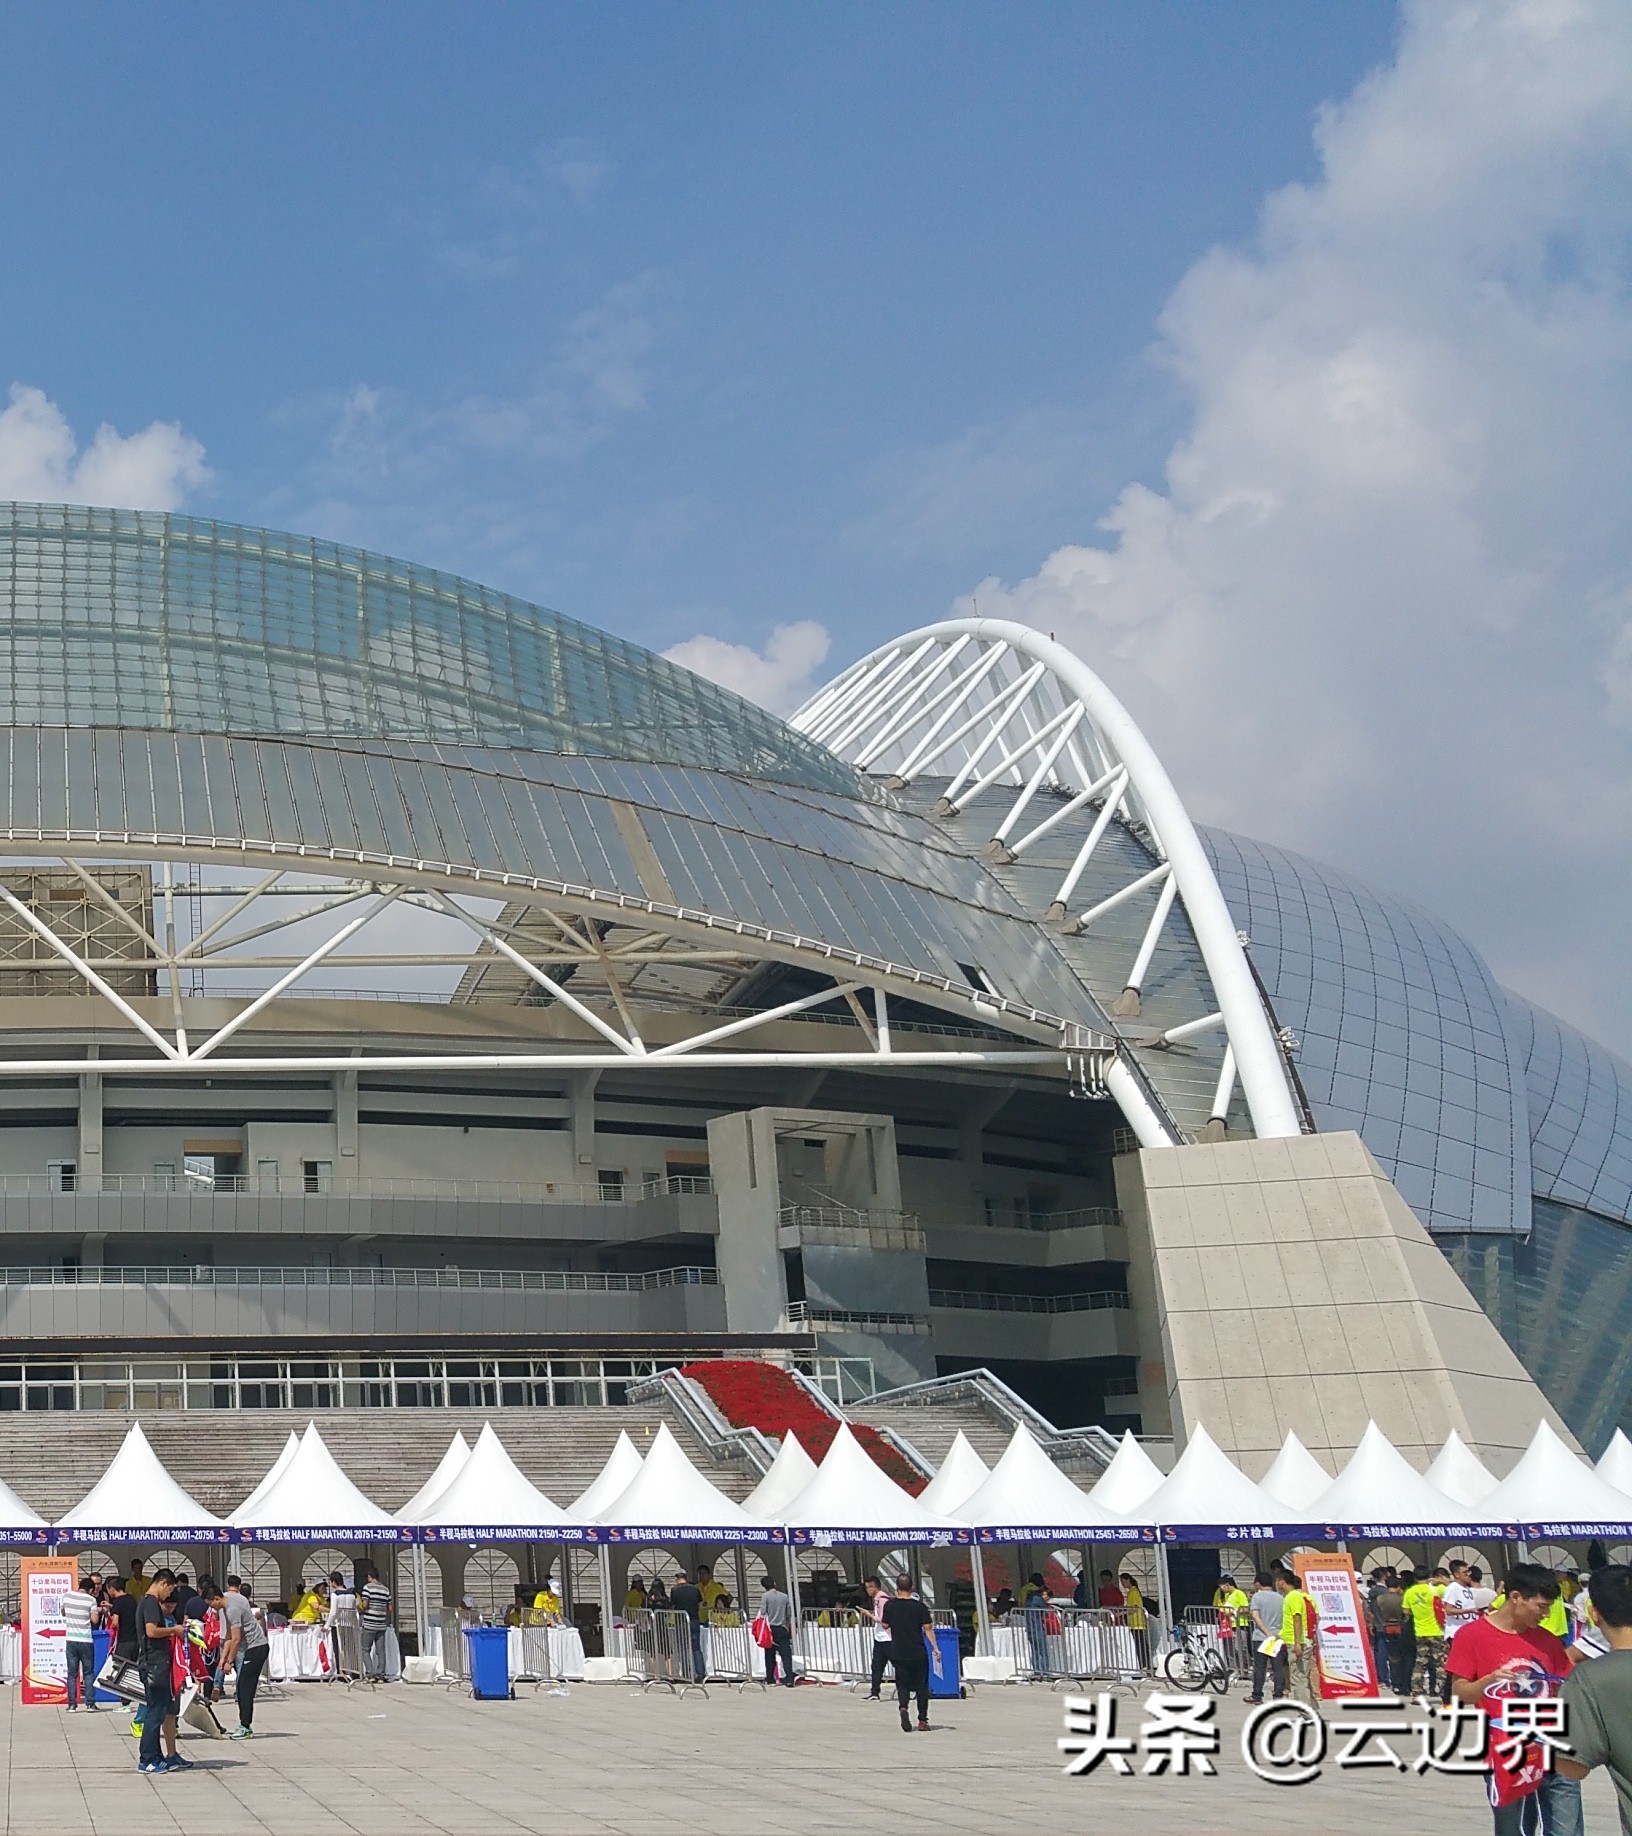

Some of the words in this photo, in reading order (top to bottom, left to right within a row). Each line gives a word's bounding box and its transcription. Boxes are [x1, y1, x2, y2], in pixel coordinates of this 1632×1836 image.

[73, 1529, 108, 1542] 半程马拉松
[109, 1530, 127, 1540] HALF
[128, 1530, 170, 1540] MARATHON
[171, 1530, 215, 1540] 20001-20750
[255, 1529, 290, 1541] 半程马拉松
[291, 1529, 310, 1539] HALF
[311, 1529, 353, 1539] MARATHON
[354, 1529, 398, 1539] 20751-21500
[440, 1528, 475, 1540] 半程马拉松
[476, 1528, 494, 1539] HALF
[495, 1528, 538, 1539] MARATHON
[539, 1529, 583, 1539] 21501-22250
[624, 1528, 660, 1540] 半程马拉松
[661, 1528, 680, 1539] HALF
[681, 1529, 723, 1540] MARATHON
[724, 1529, 768, 1541] 22251-23000
[846, 1530, 865, 1541] HALF
[865, 1530, 908, 1541] MARATHON
[995, 1528, 1032, 1541] 半程马拉松
[1032, 1529, 1051, 1539] HALF
[1052, 1529, 1095, 1539] MARATHON
[1226, 1527, 1275, 1539] 芯片检测
[1362, 1526, 1390, 1537] 马拉松
[1391, 1526, 1446, 1537] MARATHON
[1446, 1527, 1503, 1537] 10001-10750
[1542, 1525, 1571, 1536] 马拉松
[1571, 1525, 1628, 1535] MARATHON
